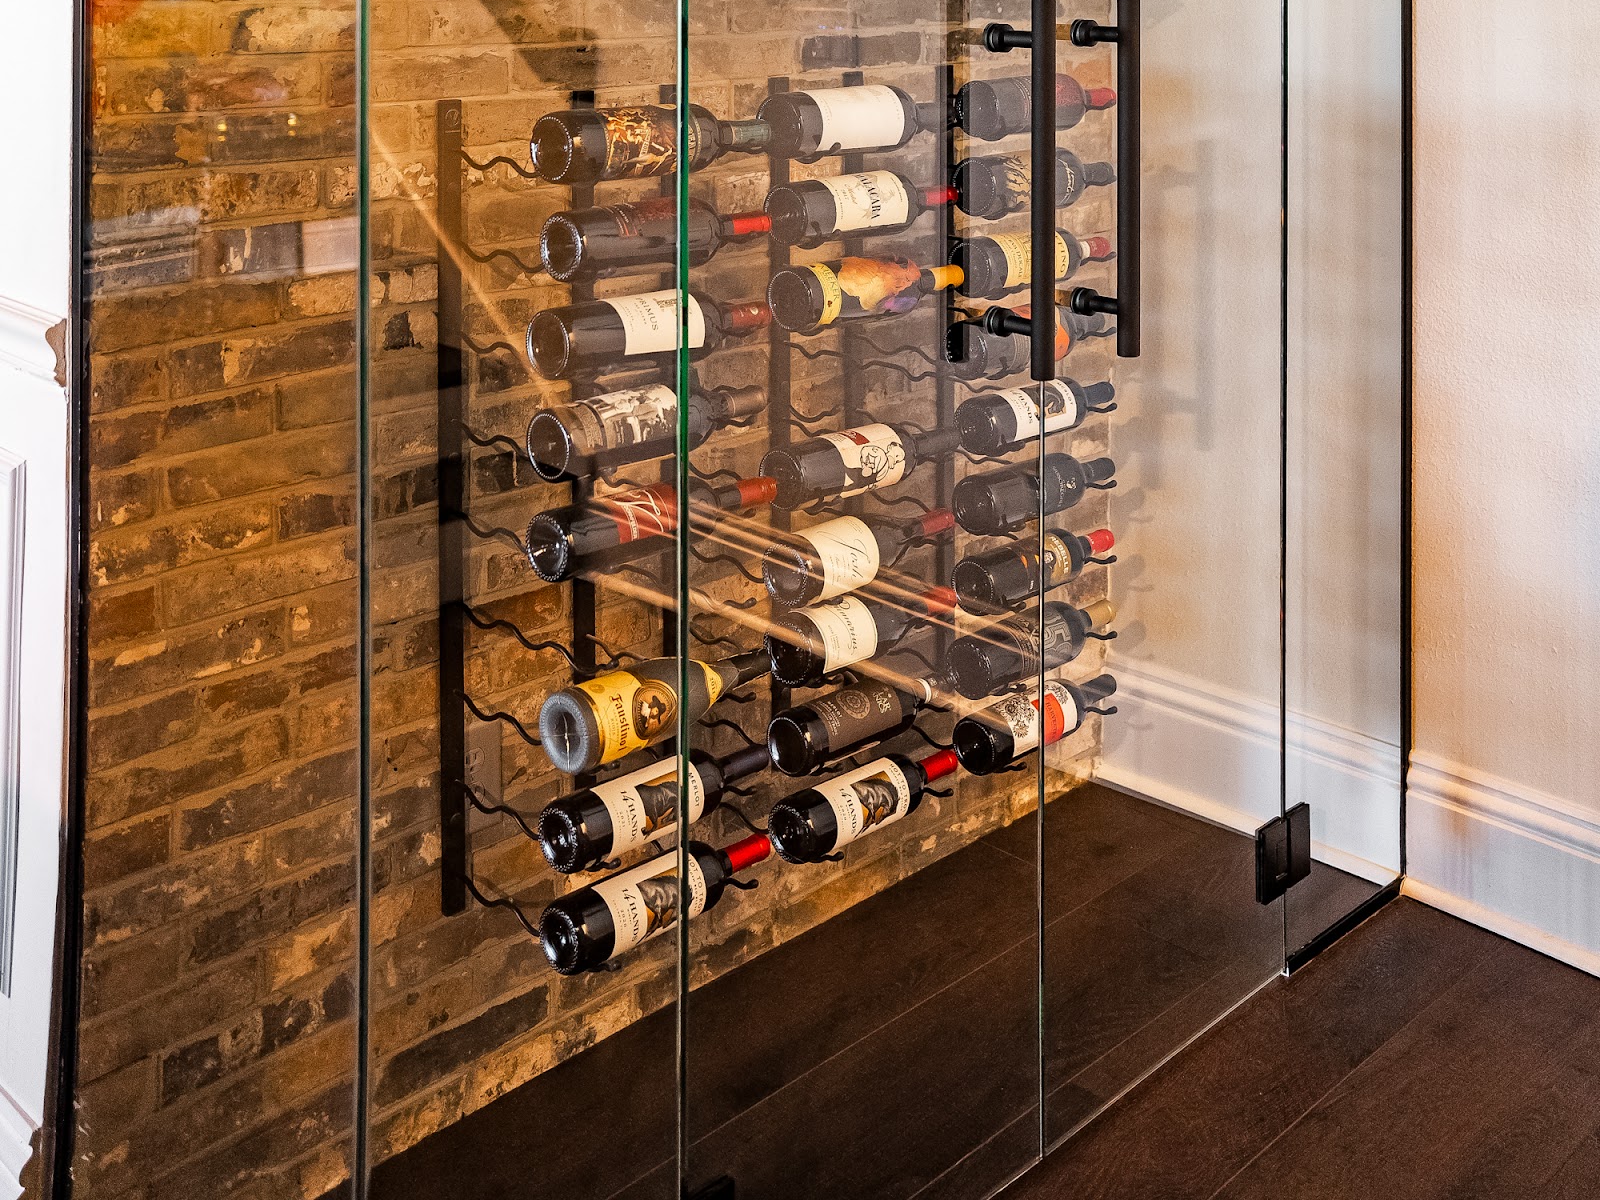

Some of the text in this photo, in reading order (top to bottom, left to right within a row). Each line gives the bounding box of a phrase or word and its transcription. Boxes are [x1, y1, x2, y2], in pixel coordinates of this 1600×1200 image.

[635, 297, 659, 331] PRIMUS
[1018, 394, 1035, 425] HANDS
[1056, 381, 1075, 406] MERLOT
[622, 504, 640, 540] DORNFELDER
[1050, 535, 1070, 574] REBELLE
[611, 692, 630, 746] Faustino
[688, 772, 701, 808] MERLOT
[889, 763, 902, 777] HOT
[899, 778, 907, 791] TO
[620, 789, 639, 843] 14 HANDS
[846, 795, 858, 834] HANDS
[696, 876, 703, 890] TO
[621, 886, 640, 943] 14 HANDS
[697, 890, 706, 914] TROT
